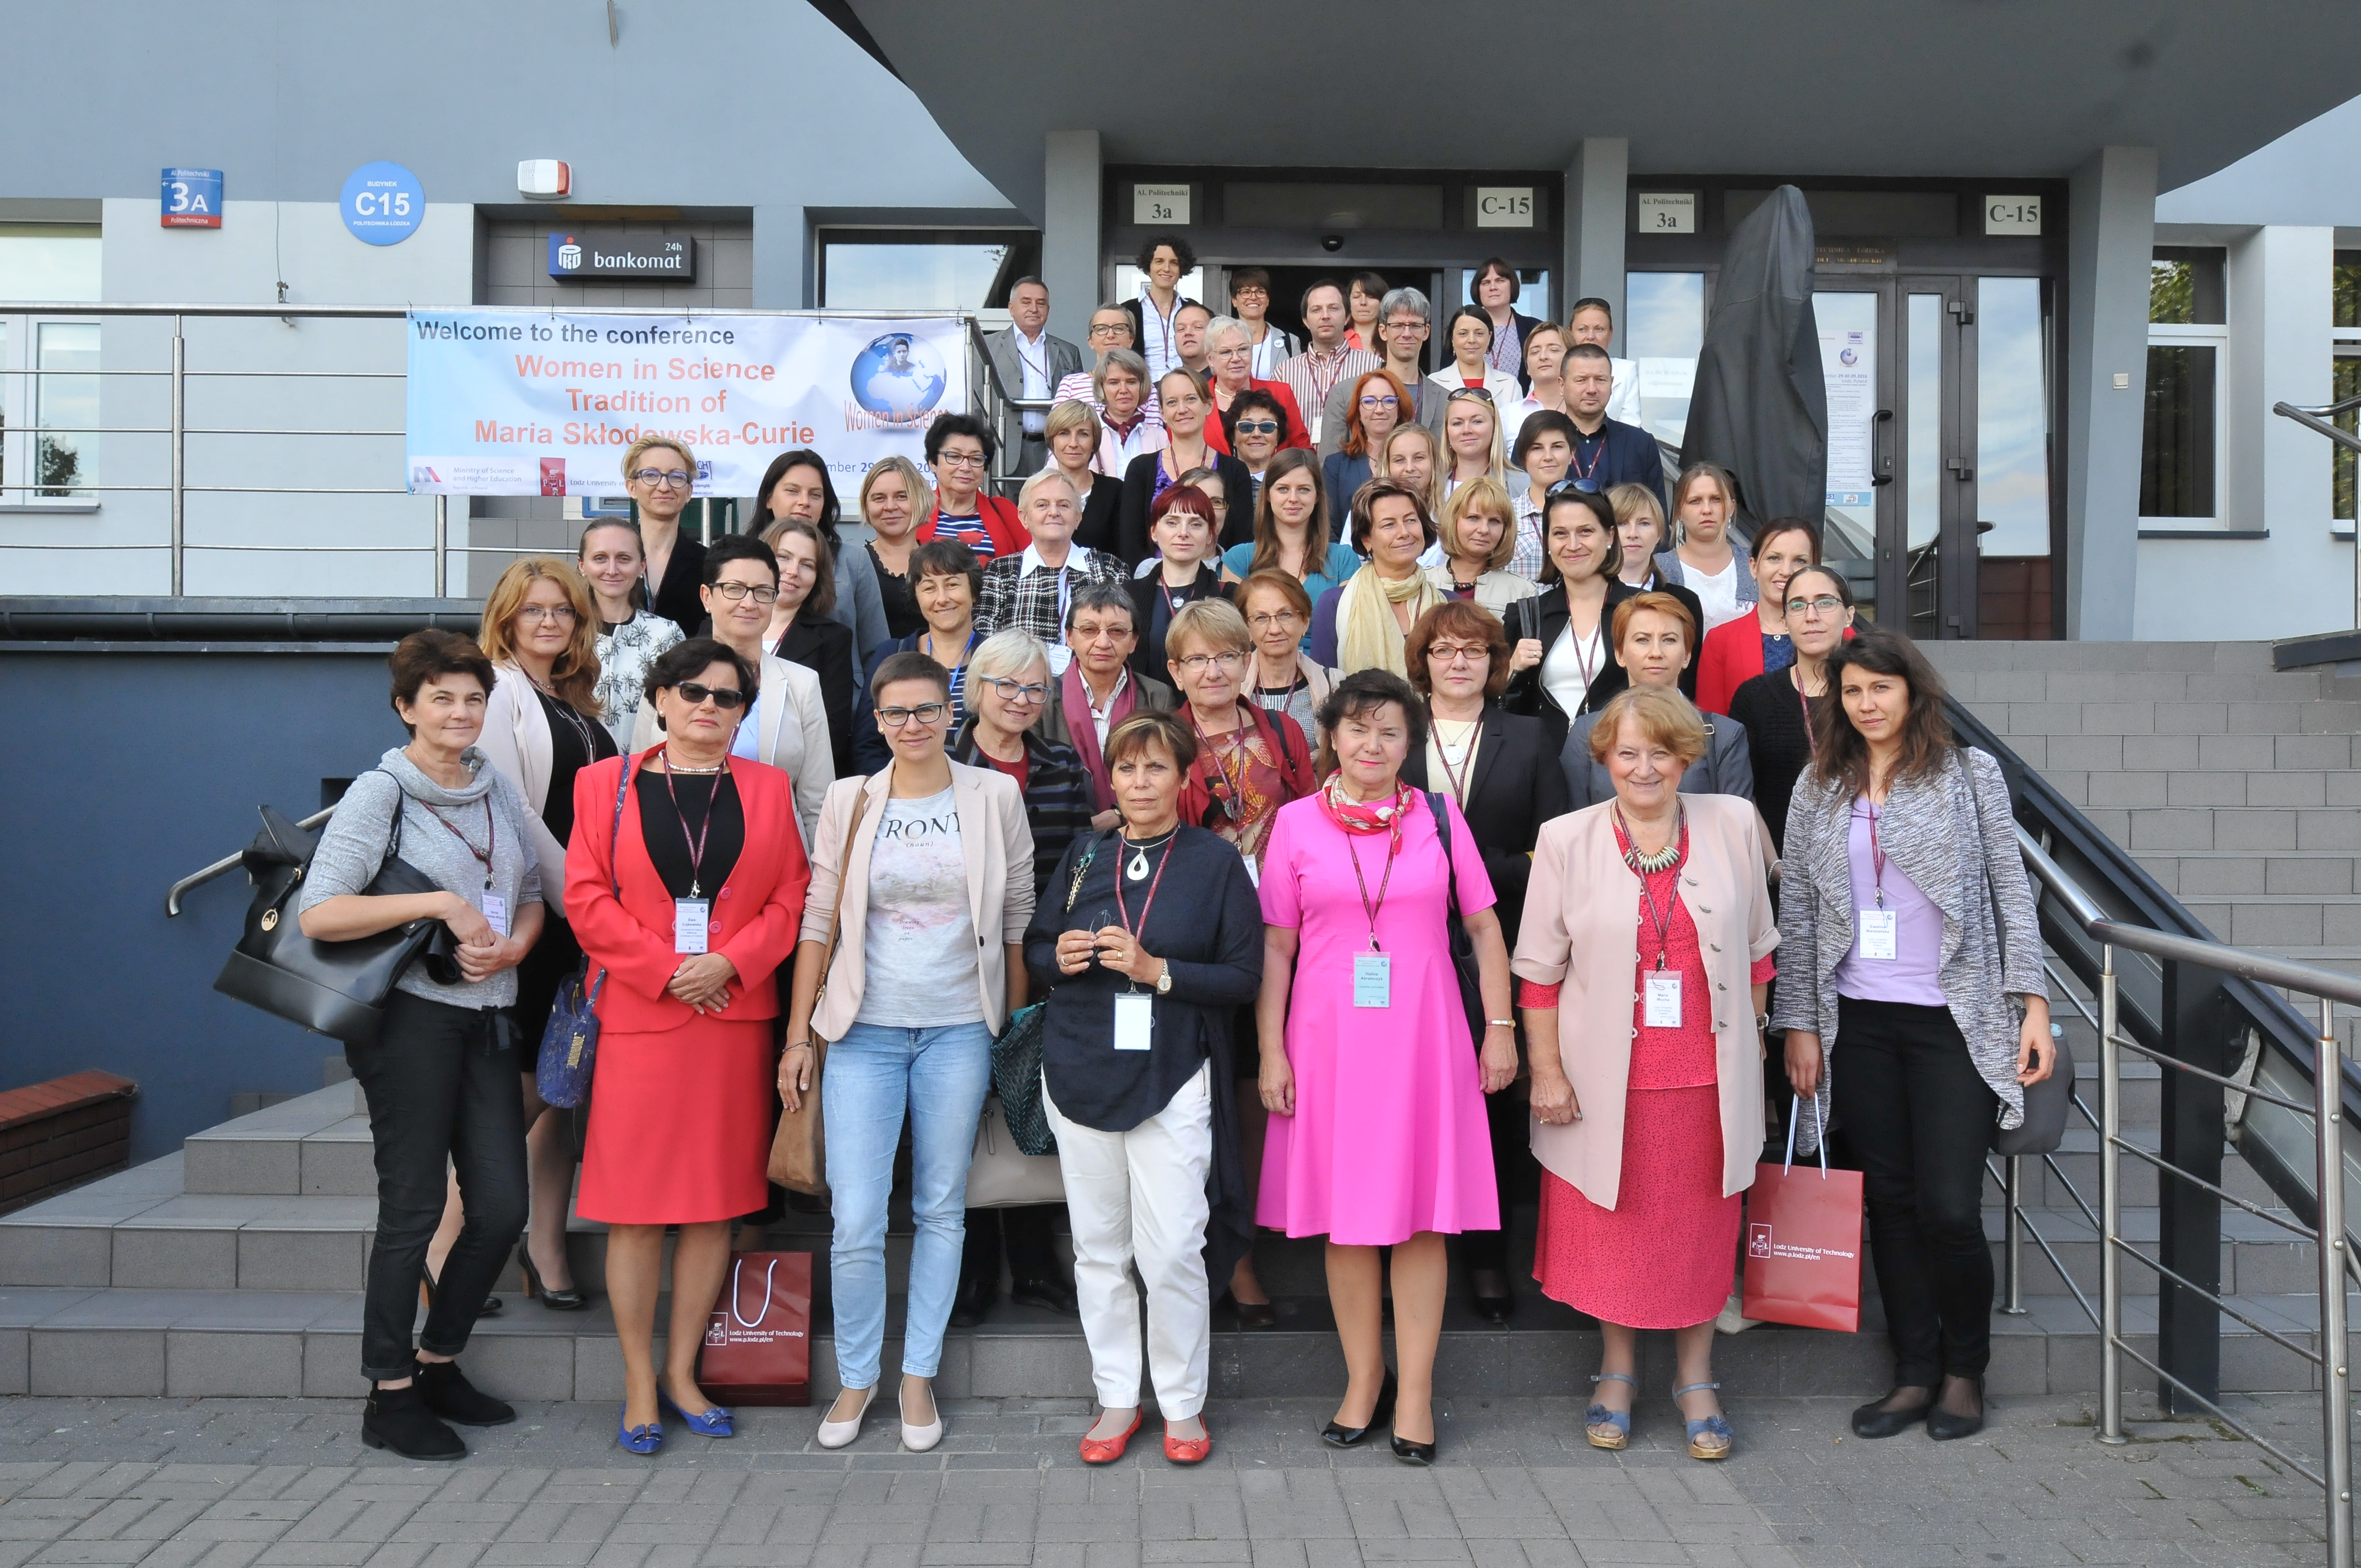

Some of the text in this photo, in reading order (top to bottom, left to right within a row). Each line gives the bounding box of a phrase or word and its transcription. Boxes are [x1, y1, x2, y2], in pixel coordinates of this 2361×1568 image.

[178, 169, 209, 178] Politechniki
[355, 192, 410, 216] C15
[1151, 203, 1172, 219] 3a
[1481, 196, 1531, 215] C-15
[1656, 213, 1677, 228] 3a
[1989, 204, 2038, 223] C-15
[665, 242, 682, 251] 24h
[594, 251, 682, 269] bankomat
[417, 320, 735, 345] Welcome to the conference
[515, 354, 775, 381] Women in Science
[565, 389, 726, 412] Tradition of
[845, 400, 889, 432] Women
[893, 406, 903, 427] in
[476, 420, 815, 445] Maria Skłodowska-Curie
[697, 460, 712, 480] GHT
[826, 461, 856, 472] mber
[1773, 1250, 1821, 1260] www.p.lodz.pl/en
[1787, 1244, 1815, 1254] University
[1823, 1249, 1855, 1259] Technology
[743, 1330, 768, 1338] University
